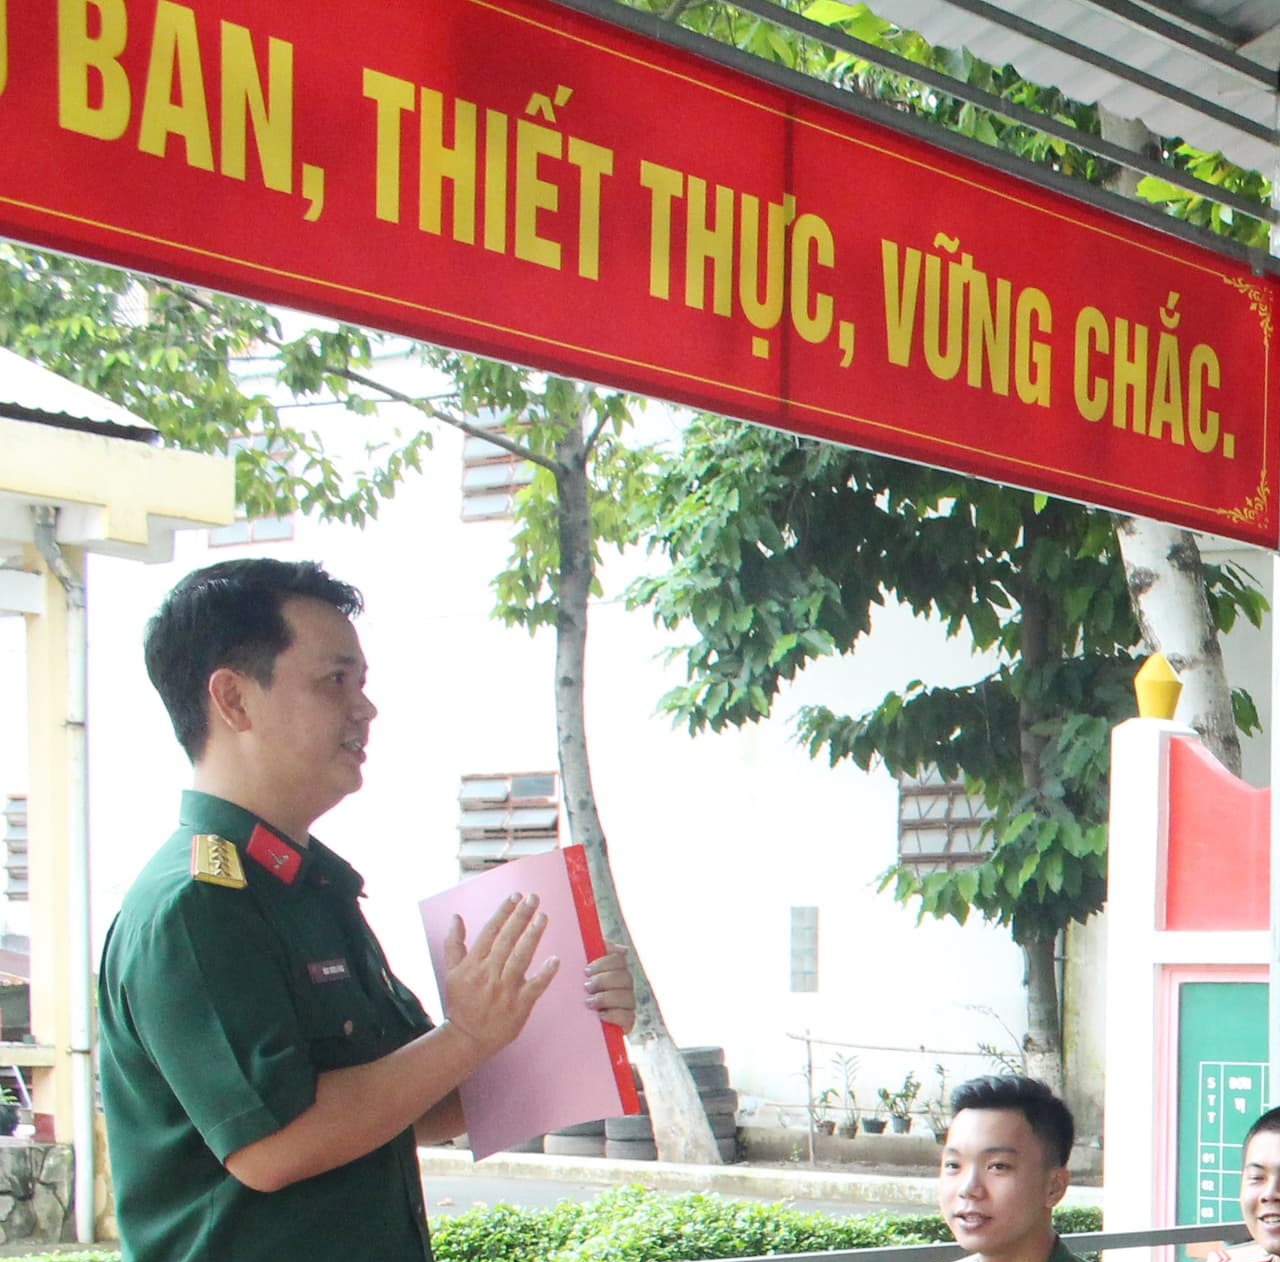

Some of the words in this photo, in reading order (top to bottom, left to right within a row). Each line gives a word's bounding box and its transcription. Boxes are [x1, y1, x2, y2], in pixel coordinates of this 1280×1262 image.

[363, 67, 613, 281] THIẾT
[641, 159, 855, 368] THỰC,
[882, 232, 1052, 408] VỮNG
[1073, 291, 1234, 459] CHẮC.
